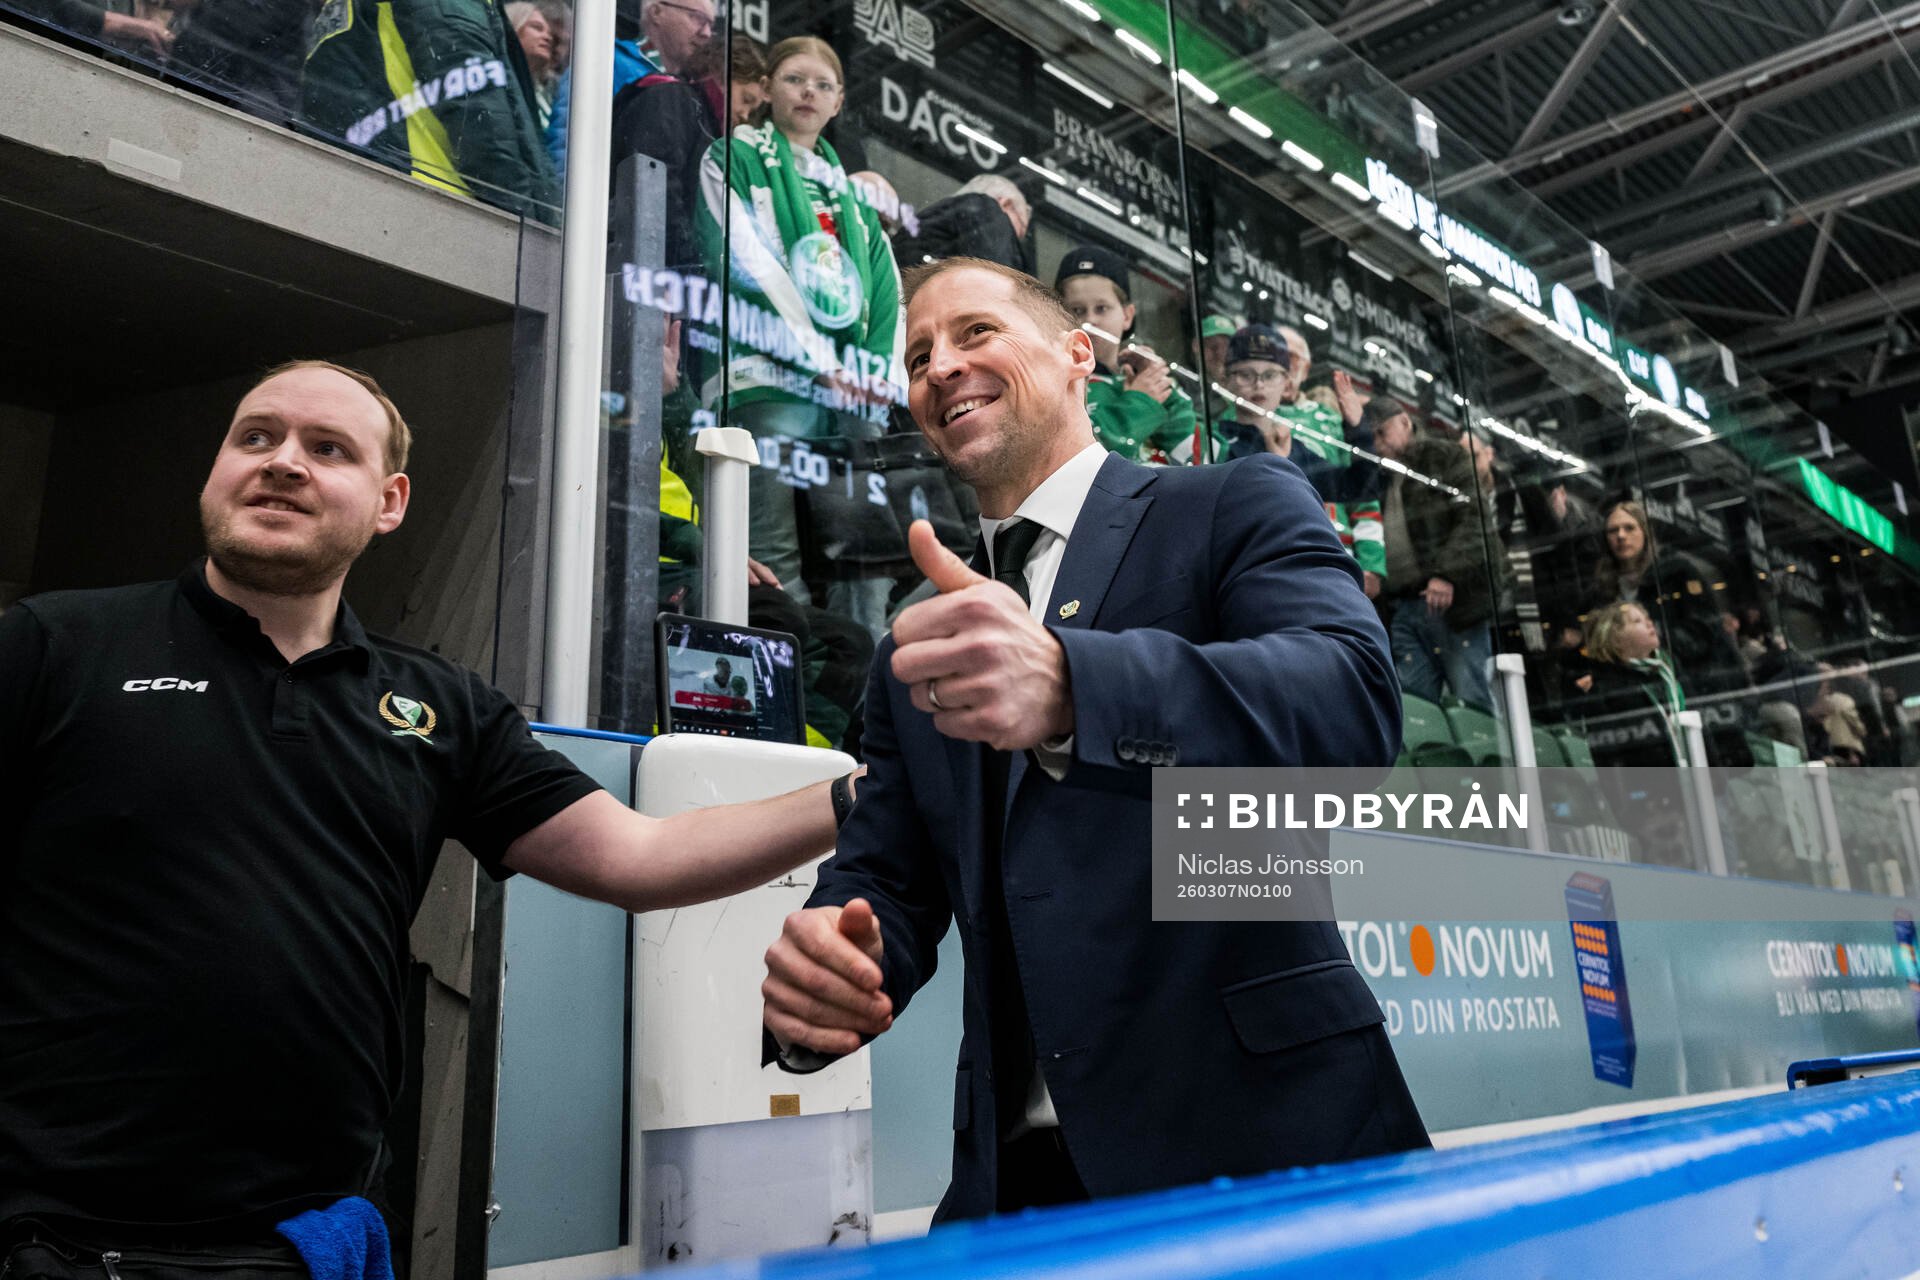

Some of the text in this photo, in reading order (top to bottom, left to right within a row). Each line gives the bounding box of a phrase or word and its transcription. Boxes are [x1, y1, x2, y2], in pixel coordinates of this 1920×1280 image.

[122, 677, 209, 693] CCM
[1336, 920, 1554, 978] TOL NOVUM
[1377, 999, 1404, 1036] D
[1411, 999, 1456, 1034] DIN
[1461, 996, 1561, 1033] PROSTATA
